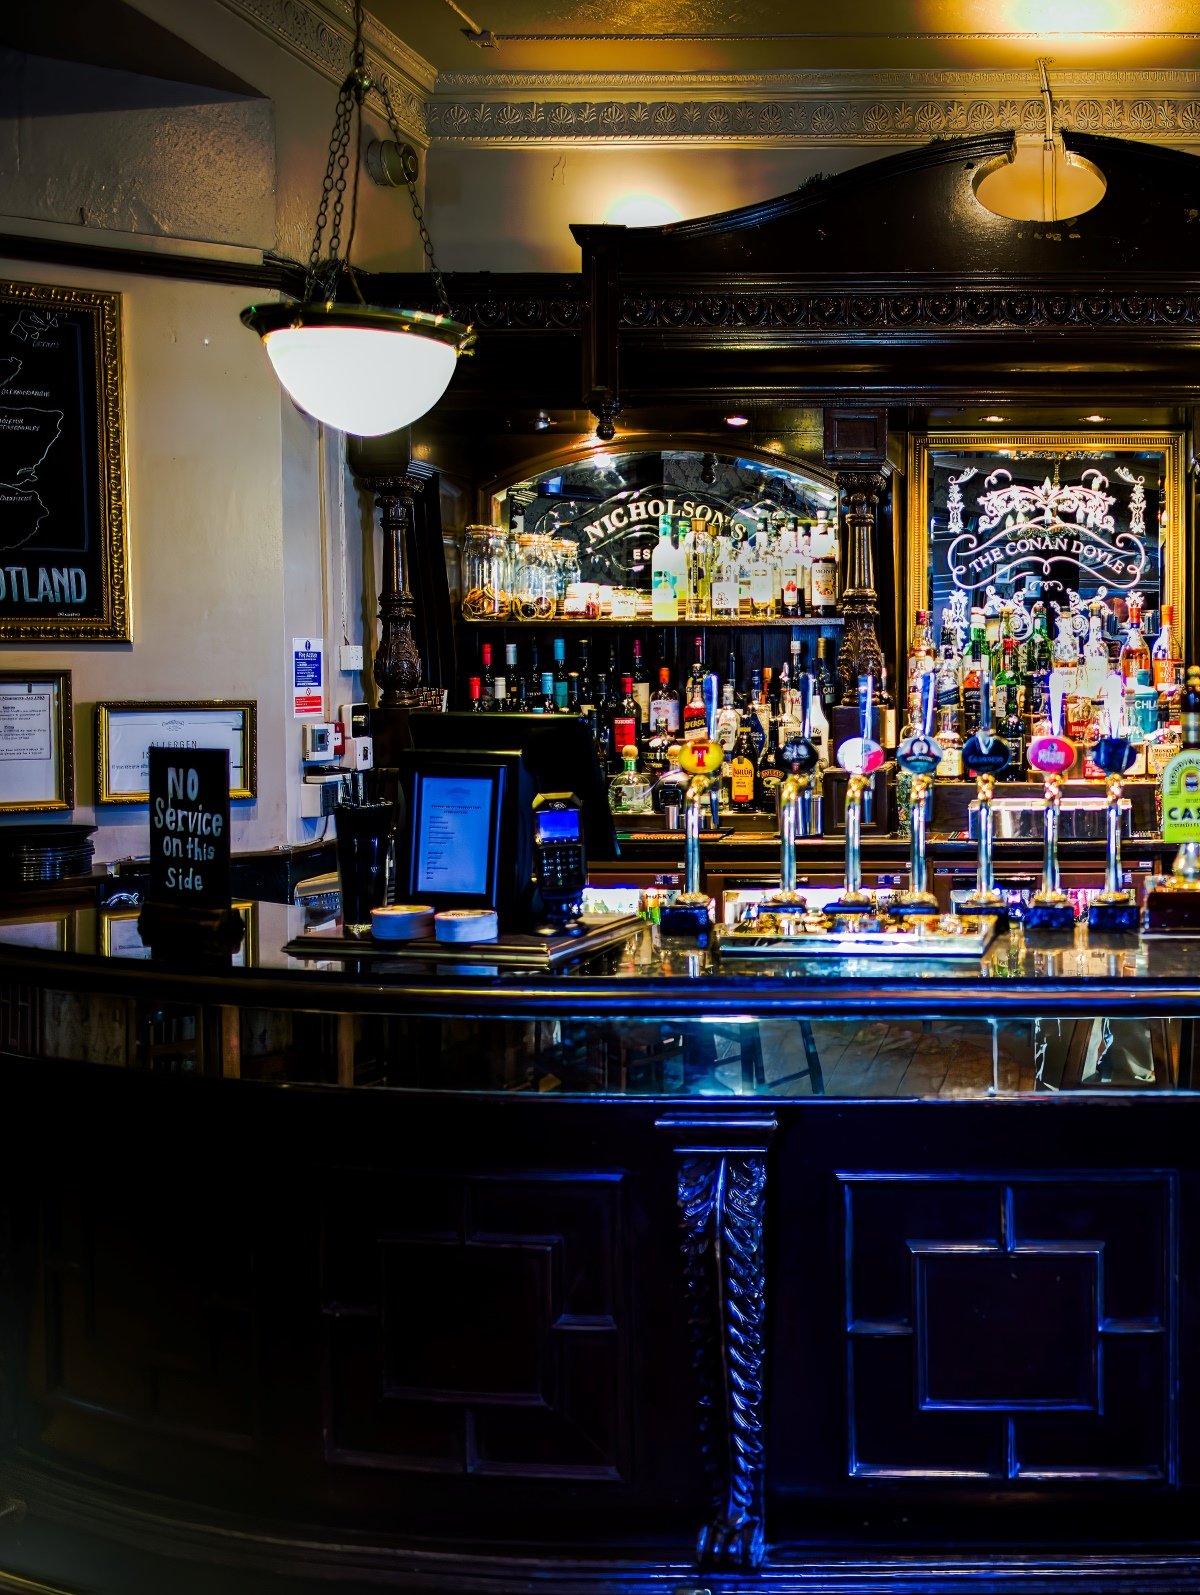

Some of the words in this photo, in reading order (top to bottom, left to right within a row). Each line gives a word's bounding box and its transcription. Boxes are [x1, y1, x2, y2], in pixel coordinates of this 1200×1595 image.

[633, 550, 652, 561] ES
[968, 547, 1005, 573] THE
[1005, 537, 1068, 556] CONAN
[1071, 540, 1126, 574] DOYLE
[684, 718, 706, 730] APEROL
[691, 745, 710, 768] T
[167, 767, 199, 800] NO
[154, 797, 223, 837] Service
[163, 836, 183, 857] on
[186, 839, 215, 861] this
